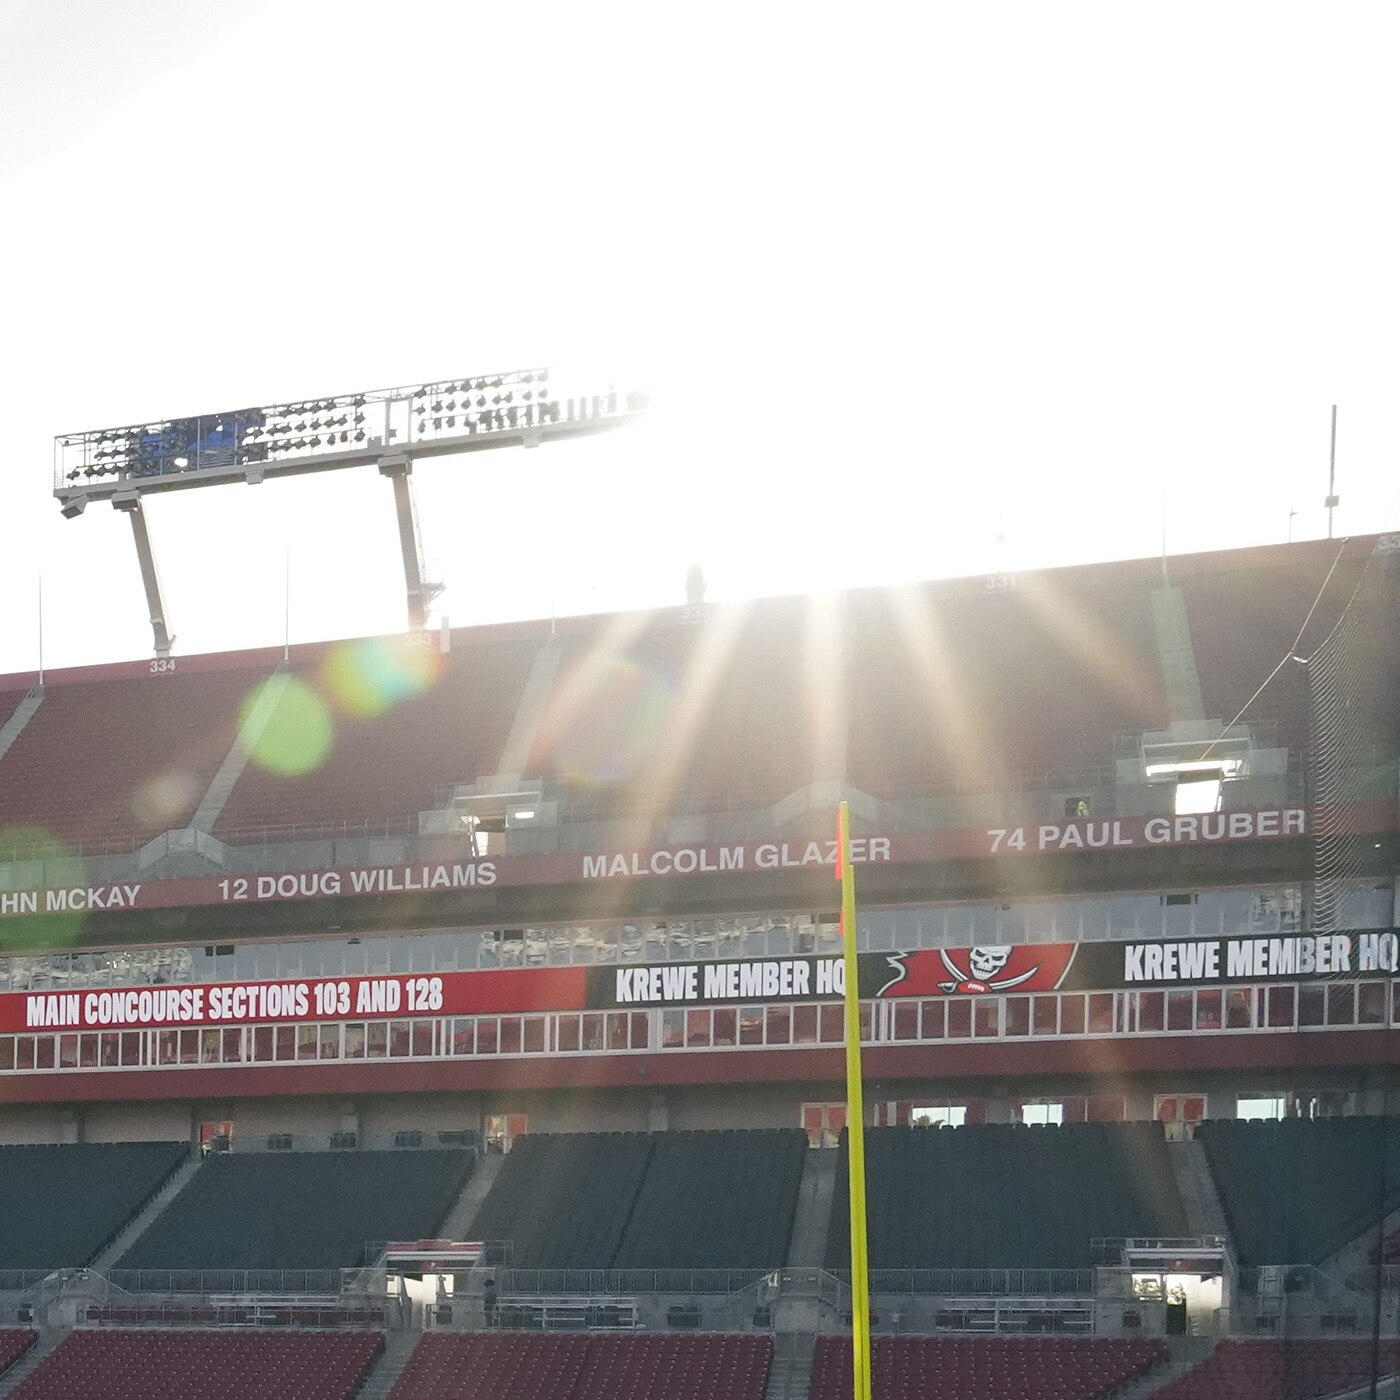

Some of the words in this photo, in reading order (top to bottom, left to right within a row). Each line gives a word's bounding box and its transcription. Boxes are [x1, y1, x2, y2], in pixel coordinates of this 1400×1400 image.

[149, 659, 176, 673] 334
[987, 828, 1026, 854] 74
[1038, 820, 1133, 851] PAUL
[1144, 808, 1306, 845] GRUBER
[583, 847, 745, 880] MALCOLM
[755, 836, 891, 868] GLAZER
[45, 884, 141, 913] MCKAY
[218, 877, 249, 901] 12
[256, 872, 342, 899] DOUG
[350, 862, 497, 894] WILLIAMS
[1124, 941, 1221, 982] KREWE
[1226, 935, 1351, 978] MEMBER
[1357, 932, 1398, 973] HQ
[26, 994, 80, 1028] MAIN
[84, 989, 204, 1025] CONCOURSE
[208, 984, 309, 1020] SECTIONS
[314, 981, 351, 1016] 103
[356, 979, 401, 1013] AND
[406, 977, 444, 1011] 128
[615, 964, 698, 1003] KREWE
[703, 959, 810, 999] MEMBER
